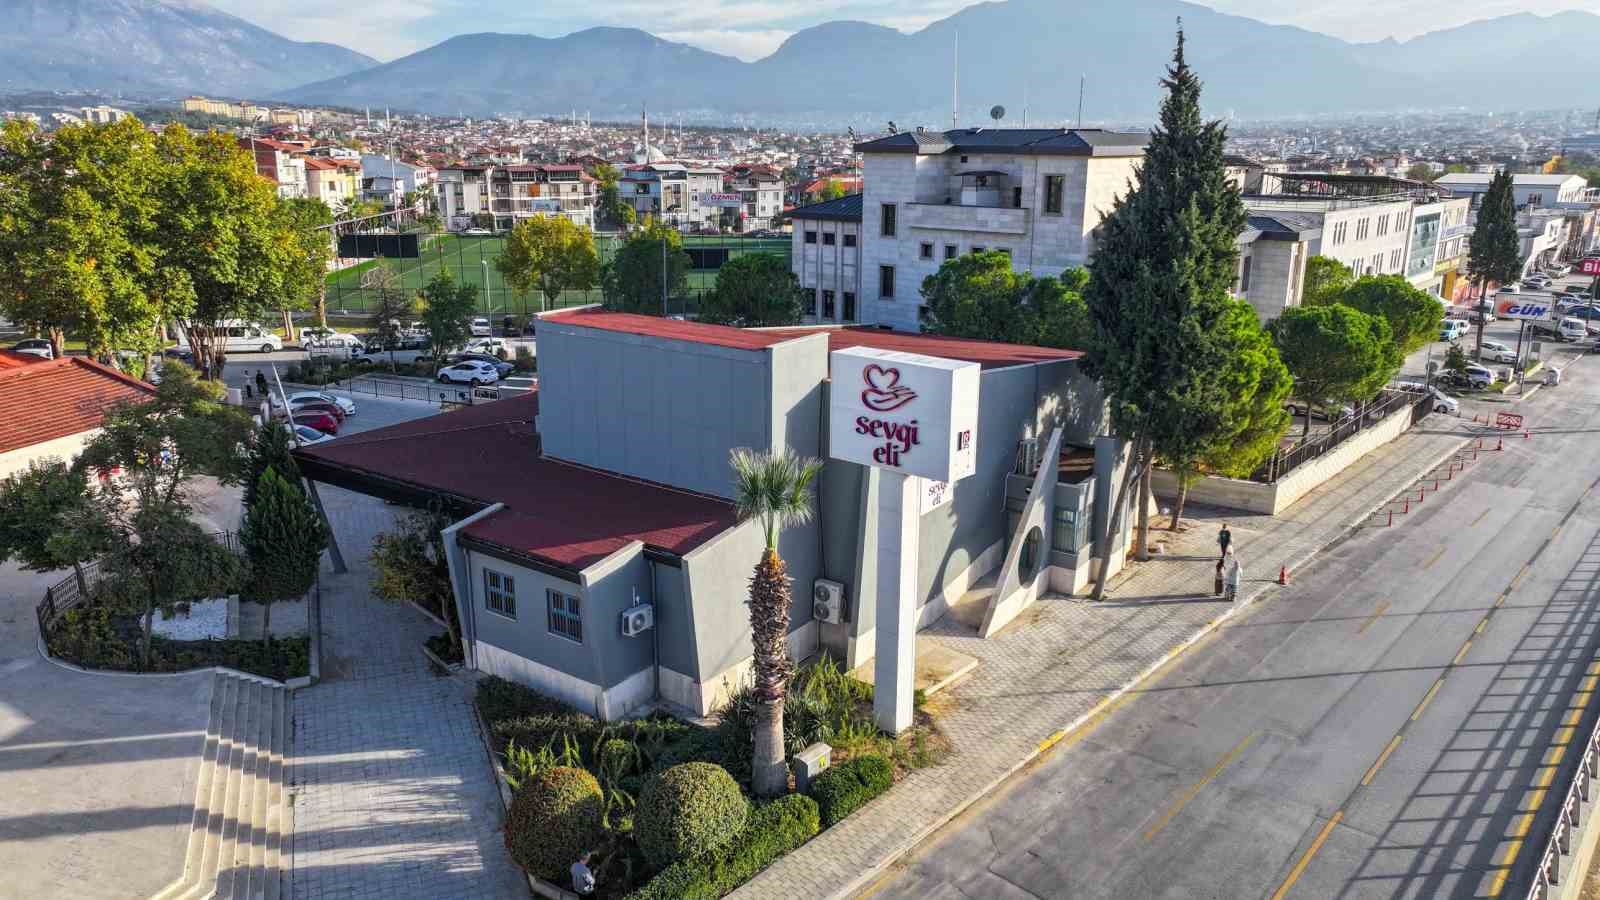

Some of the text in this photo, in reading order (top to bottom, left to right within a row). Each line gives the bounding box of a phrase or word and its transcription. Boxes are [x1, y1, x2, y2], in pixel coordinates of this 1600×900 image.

[1584, 260, 1600, 273] Bİ
[1507, 303, 1546, 316] GÜN
[856, 416, 920, 454] sevgi
[873, 442, 901, 467] eli
